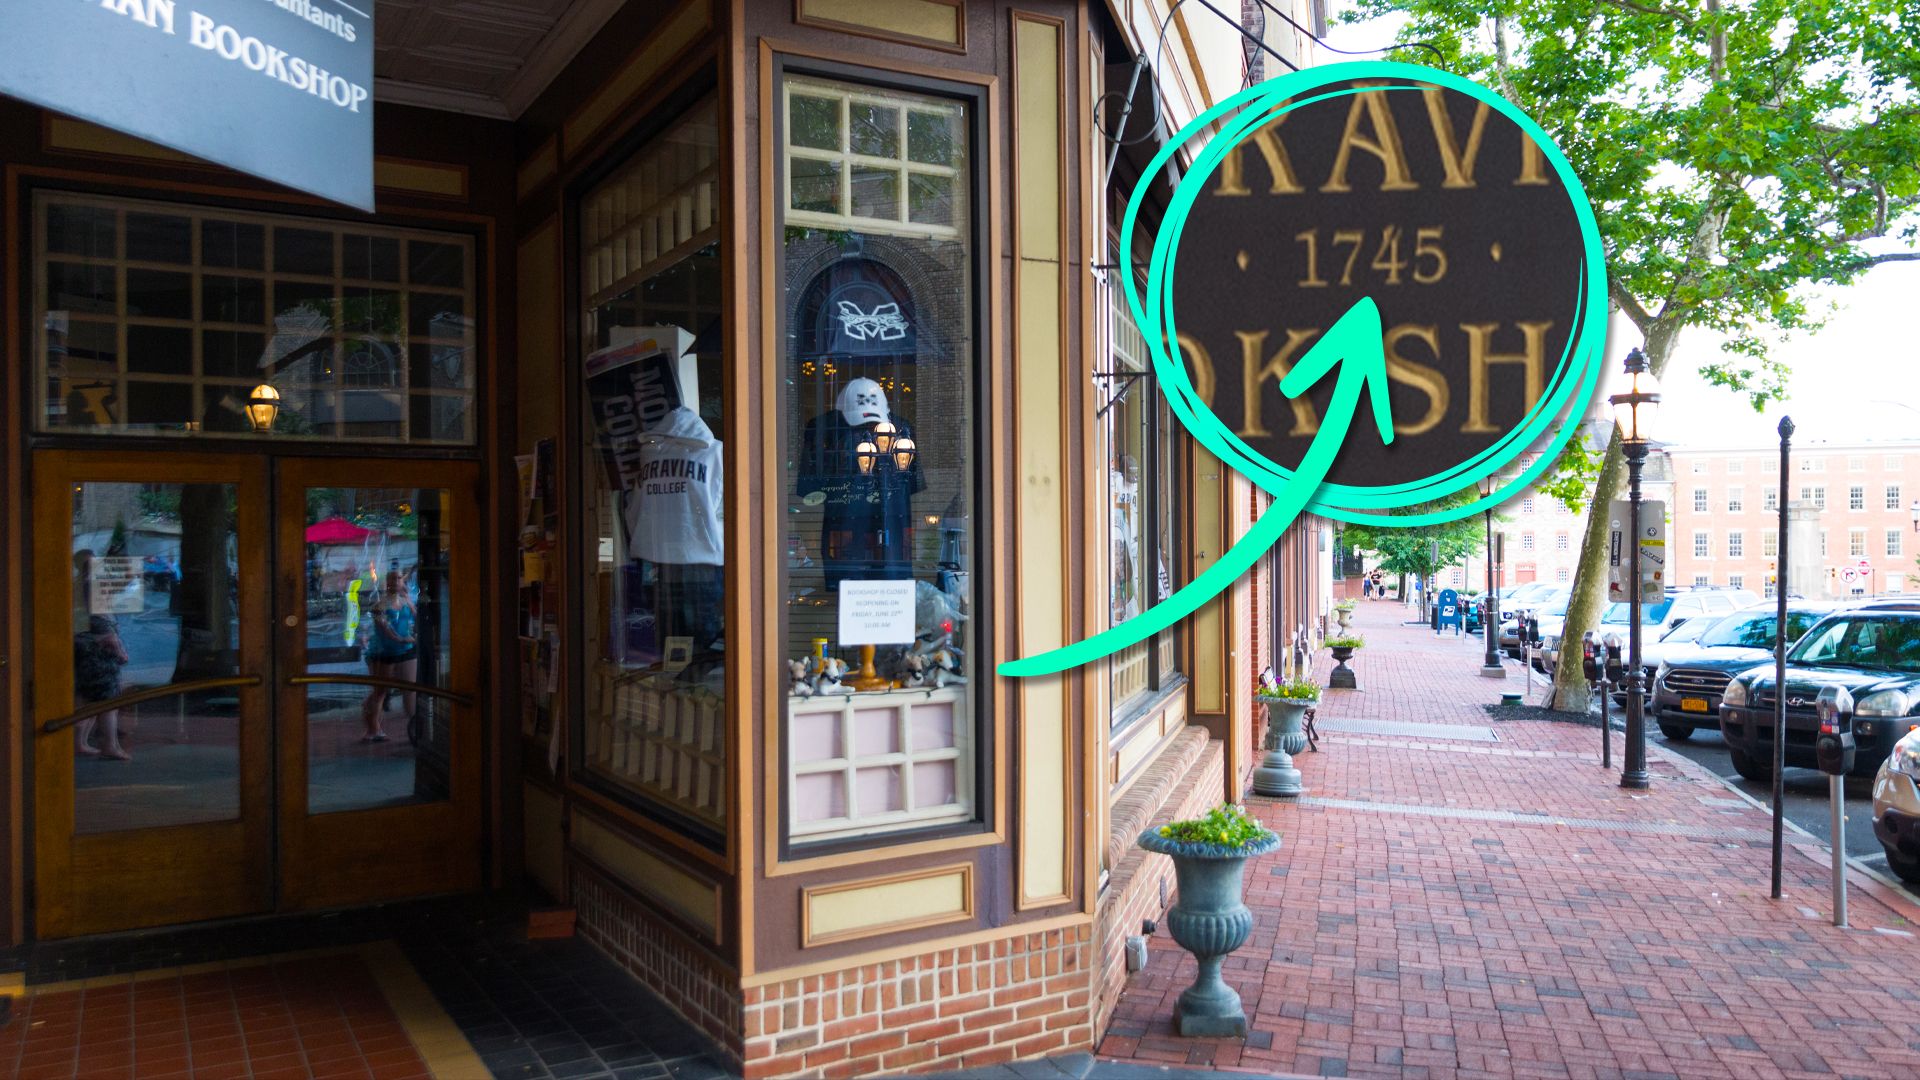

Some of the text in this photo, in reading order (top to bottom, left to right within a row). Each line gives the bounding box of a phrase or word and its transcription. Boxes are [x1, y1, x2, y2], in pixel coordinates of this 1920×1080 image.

[99, 0, 368, 112] AN BOOKSHOP
[1295, 225, 1448, 288] 1745
[647, 481, 687, 495] COLLEGE
